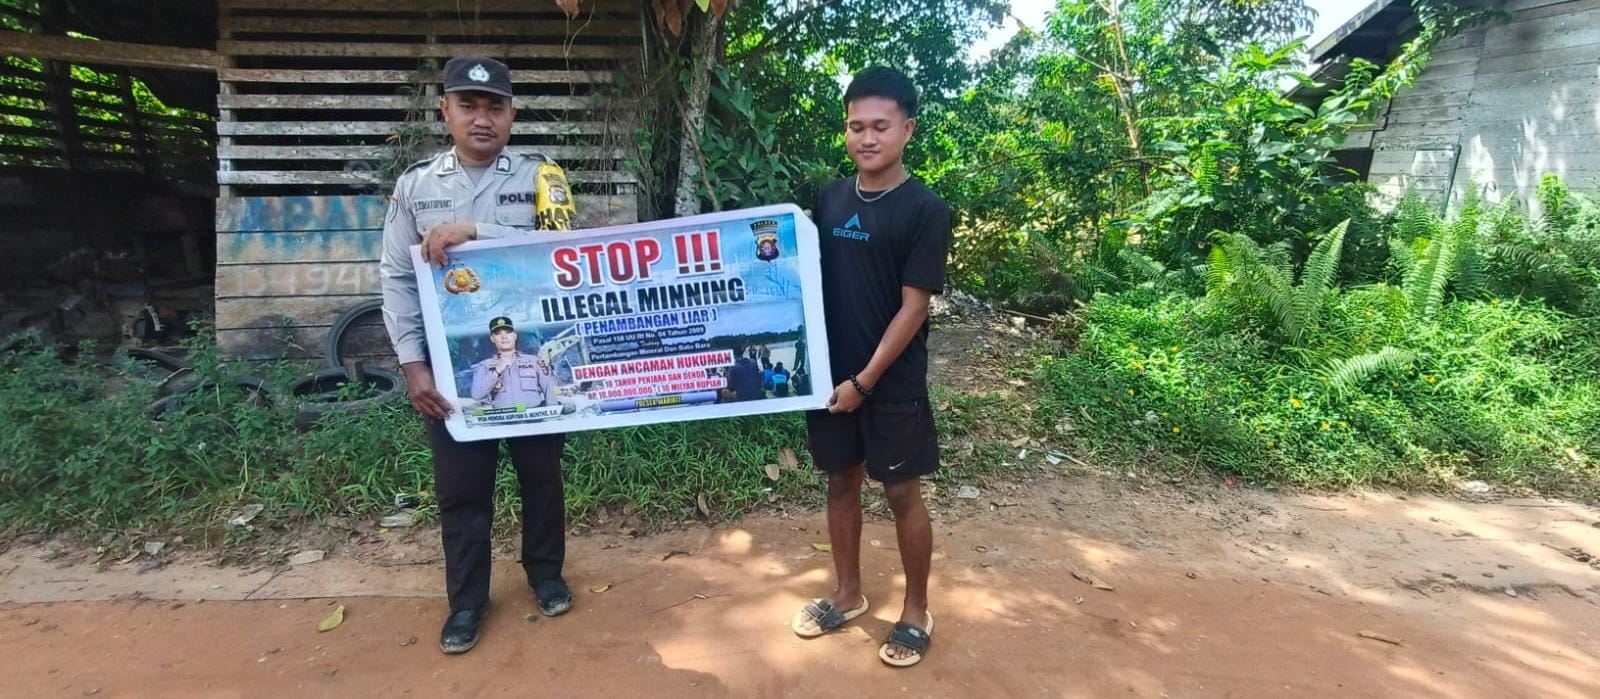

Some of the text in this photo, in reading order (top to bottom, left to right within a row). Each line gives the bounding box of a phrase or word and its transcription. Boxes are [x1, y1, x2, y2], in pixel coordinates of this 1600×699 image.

[832, 228, 870, 242] EIGER
[553, 231, 721, 288] STOP !!!
[542, 278, 745, 323] ILLEGAL MINNING
[583, 312, 680, 335] PENAMBANGAN
[681, 309, 709, 324] LIAR
[593, 334, 612, 345] Pasal
[625, 332, 636, 342] UU
[667, 328, 688, 337] Tahun
[591, 342, 710, 361] Pertambangan Mineral Dan Batu Bara
[574, 351, 732, 380] DENGAN ANCAMAN HUKUMAN
[614, 377, 637, 388] TAHUN
[638, 374, 666, 385] PENJARA
[668, 372, 682, 382] DAN
[683, 370, 705, 380] DENDA
[671, 381, 695, 392] MILYAR
[696, 379, 721, 389] RUPIAH
